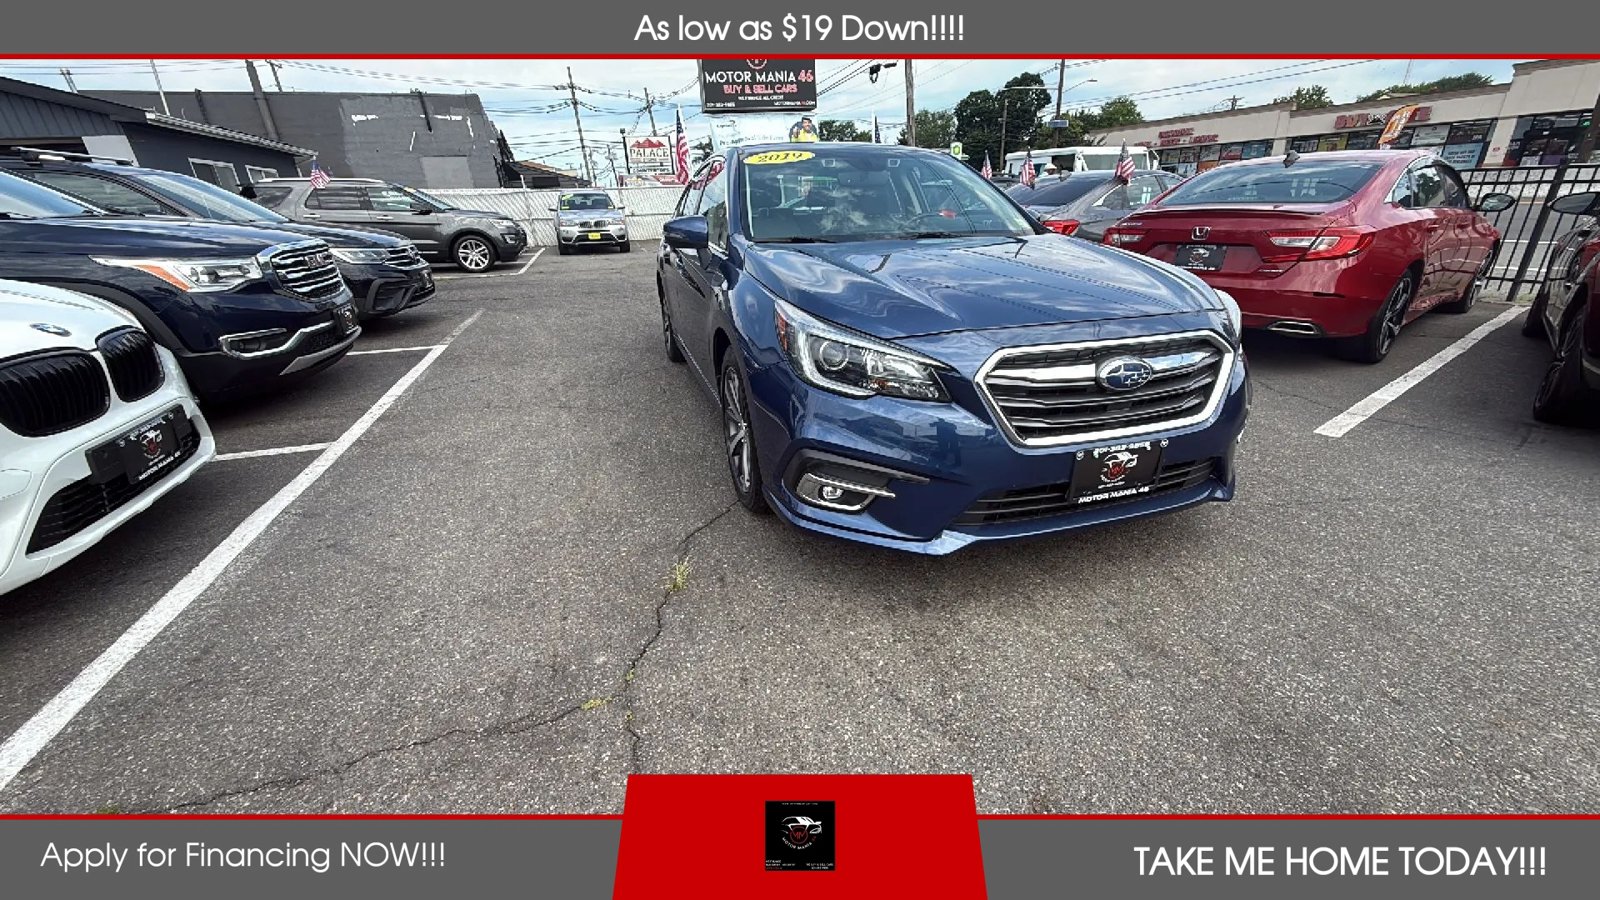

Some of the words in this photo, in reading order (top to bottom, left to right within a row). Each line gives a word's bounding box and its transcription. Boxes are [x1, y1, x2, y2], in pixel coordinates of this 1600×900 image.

[705, 71, 752, 83] MOTOR
[755, 70, 796, 82] MANIA
[798, 69, 814, 82] 46
[723, 85, 742, 94] BUY
[745, 85, 752, 94] &
[753, 84, 774, 94] SELL
[775, 84, 798, 93] CARS
[630, 148, 669, 157] PALACE
[757, 152, 803, 162] 2019
[1078, 492, 1109, 504] MOTOR
[1110, 488, 1137, 499] MANIA
